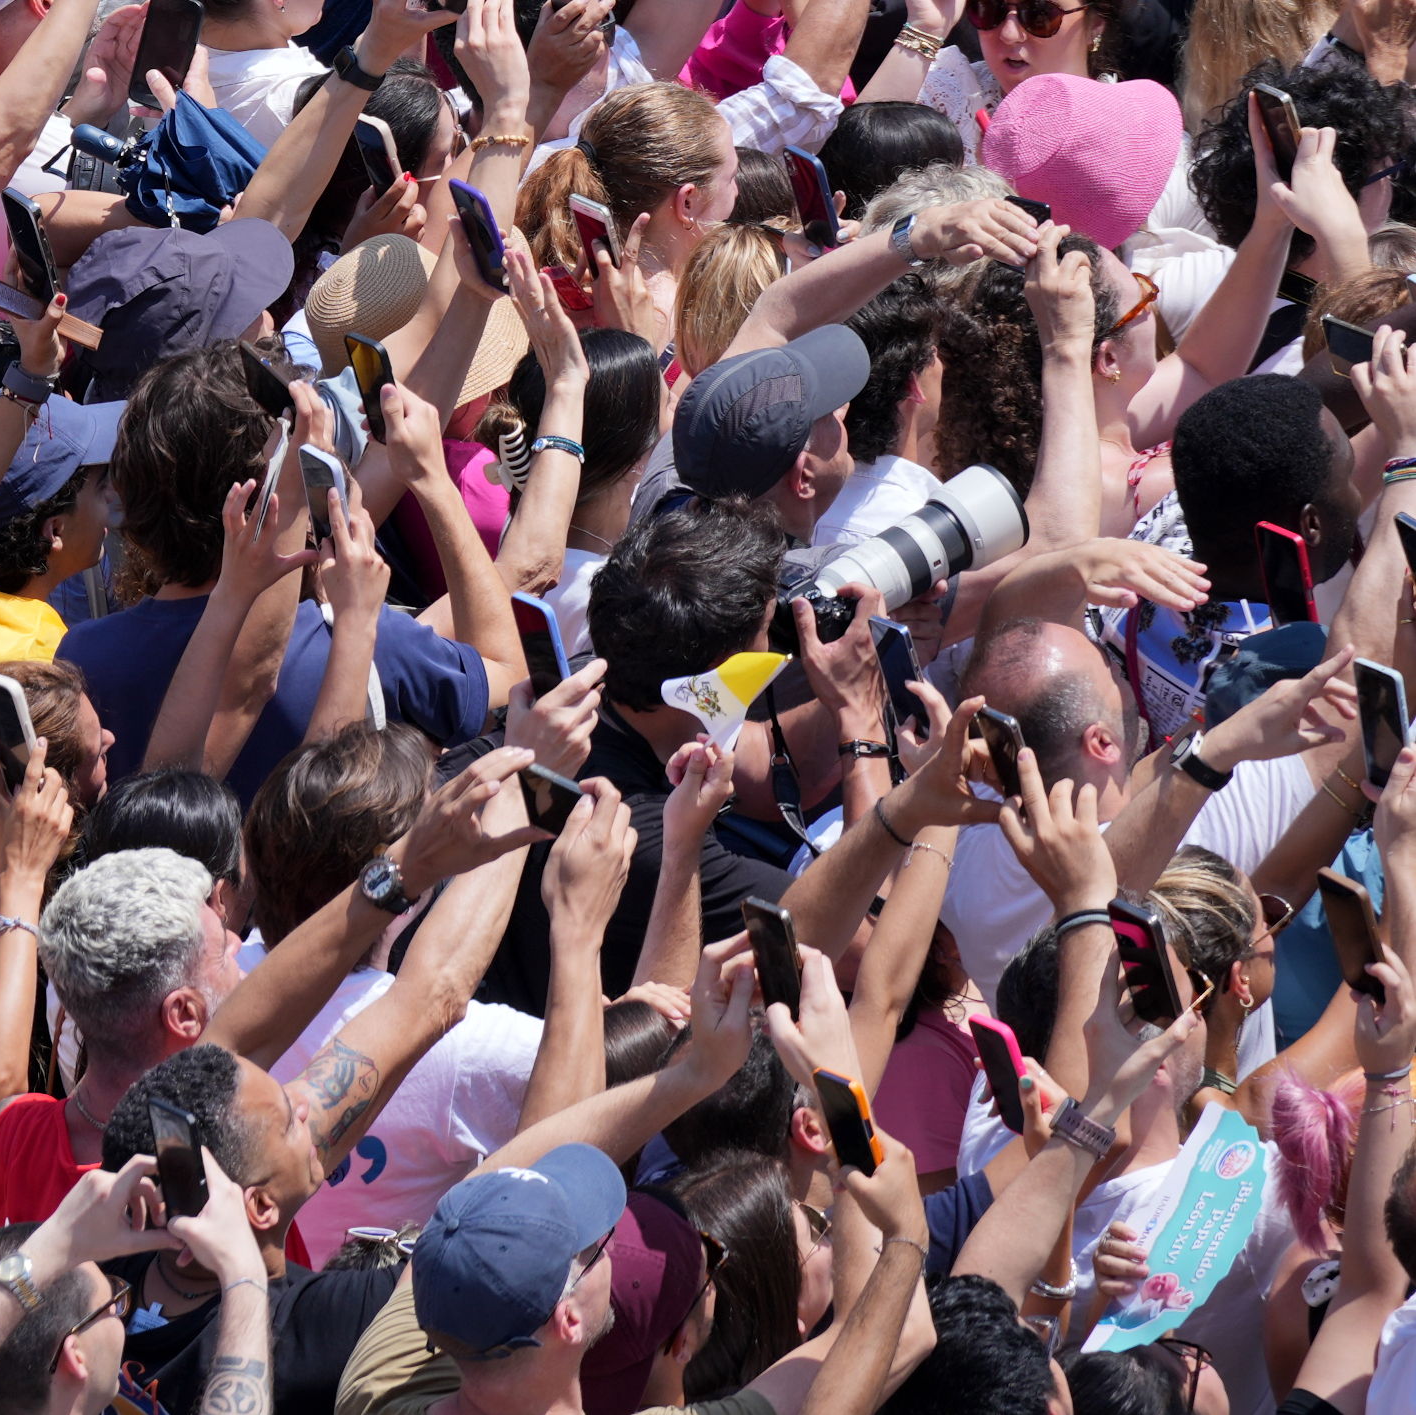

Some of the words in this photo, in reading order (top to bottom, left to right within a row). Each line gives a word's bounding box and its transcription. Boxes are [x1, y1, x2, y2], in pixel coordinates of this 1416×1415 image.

[1181, 1189, 1216, 1232] León
[1190, 1208, 1226, 1251] Papa
[1190, 1179, 1253, 1284] ¡Bienvenido,
